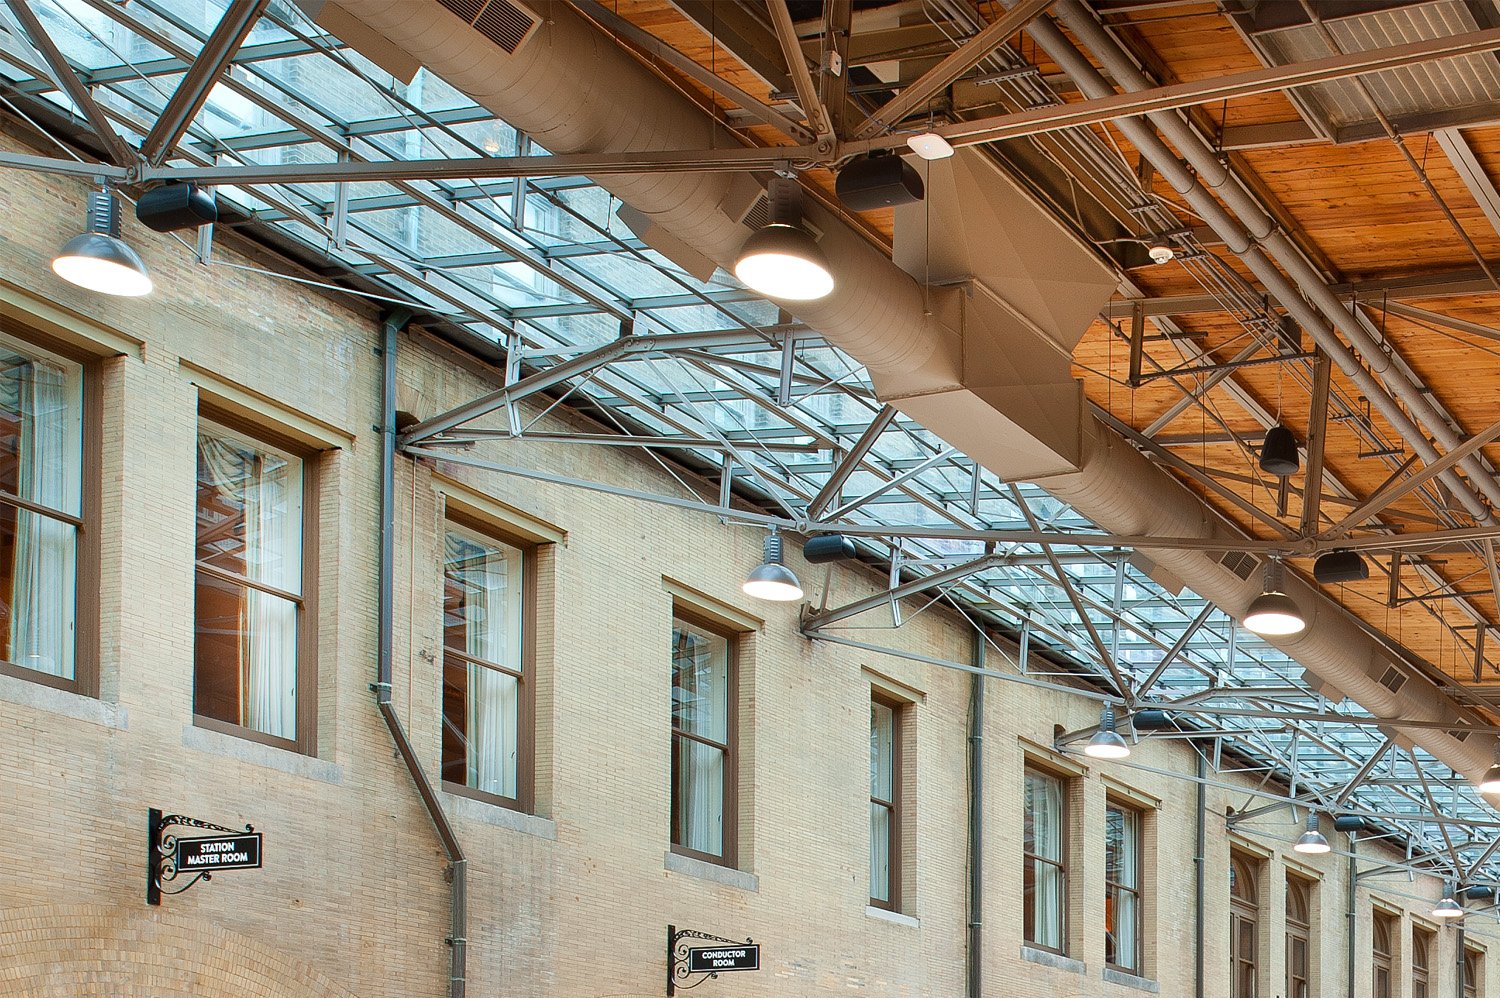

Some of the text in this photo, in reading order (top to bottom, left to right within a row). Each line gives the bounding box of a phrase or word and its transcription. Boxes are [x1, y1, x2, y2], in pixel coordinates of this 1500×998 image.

[200, 842, 235, 853] STATION
[187, 852, 249, 865] MASTER ROOM
[702, 950, 746, 959] CONDUCTOR
[712, 959, 735, 967] ROOM
